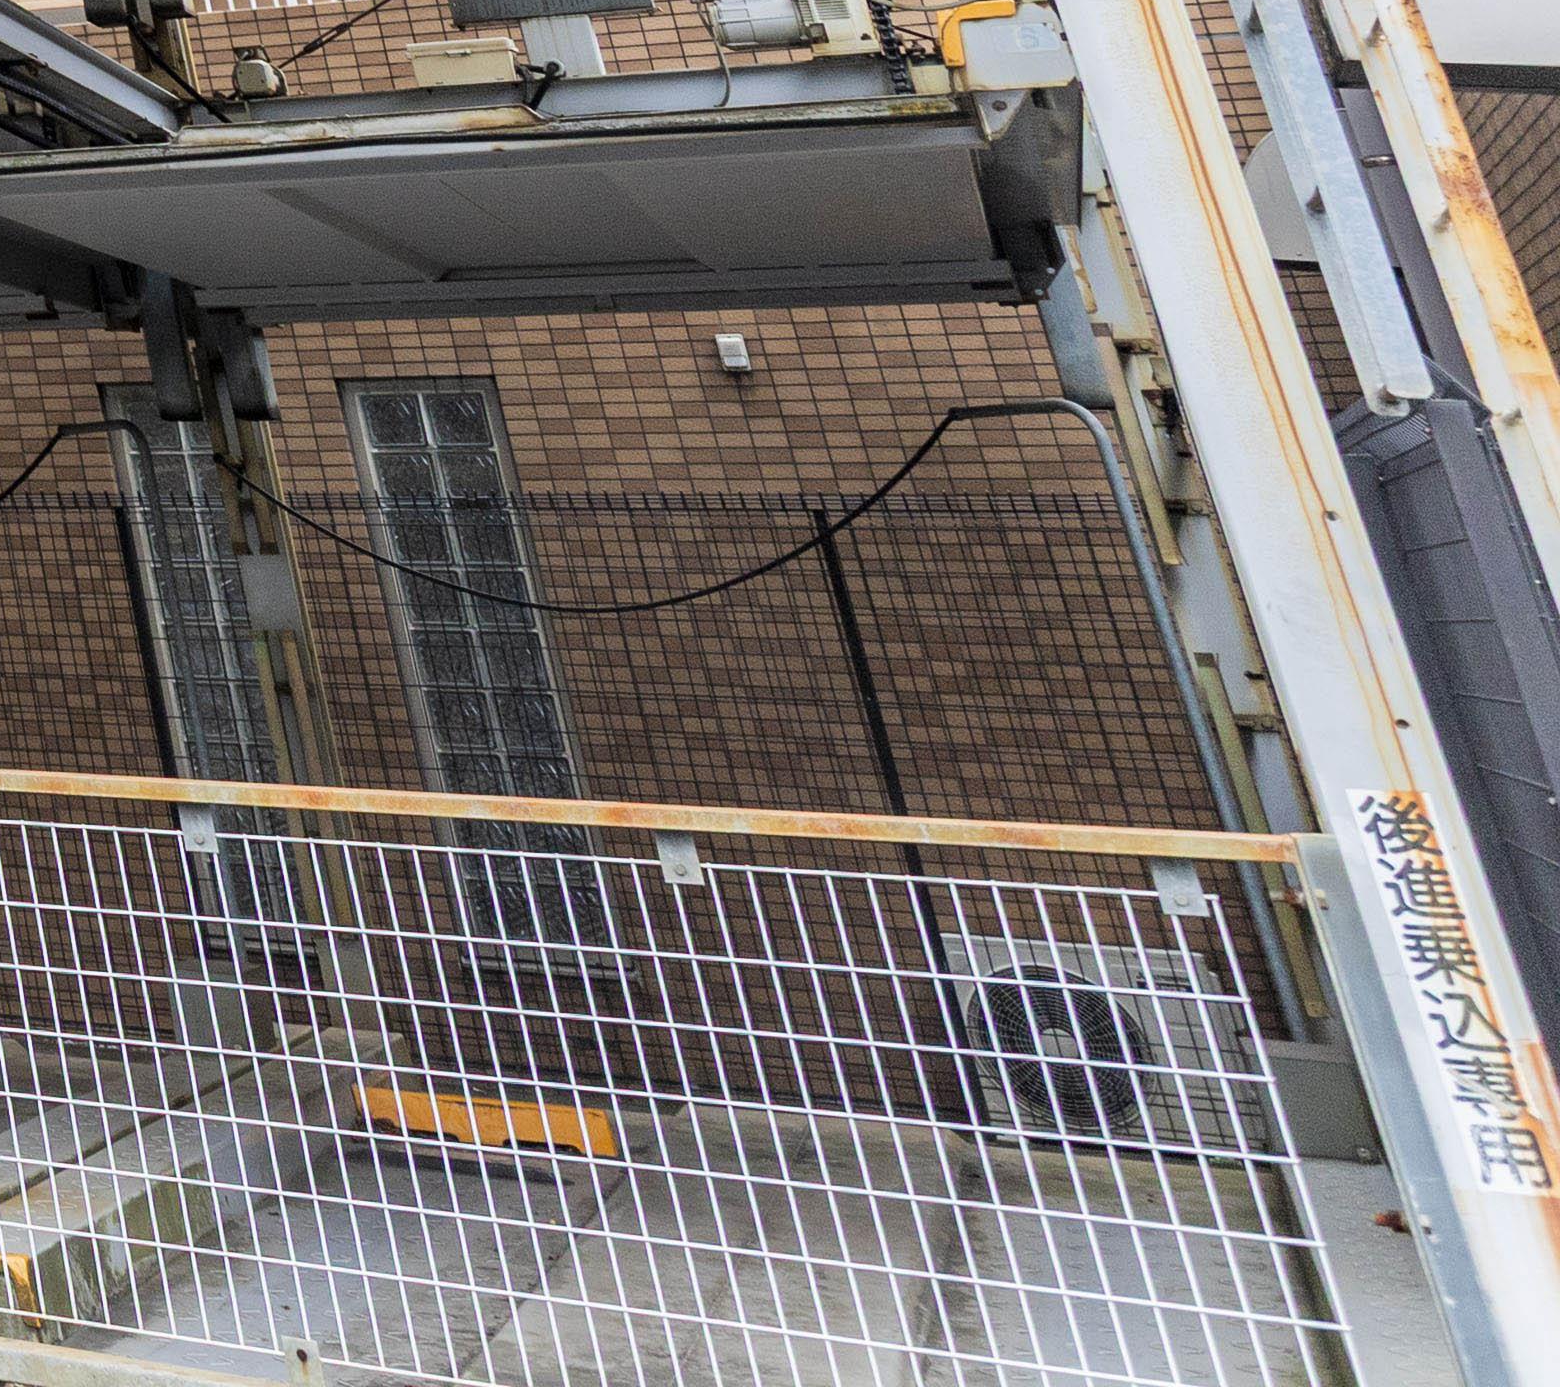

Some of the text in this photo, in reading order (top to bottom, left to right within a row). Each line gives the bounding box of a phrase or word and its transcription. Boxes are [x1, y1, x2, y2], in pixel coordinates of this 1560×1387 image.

[1358, 795, 1552, 1189] 後進乗込専用
